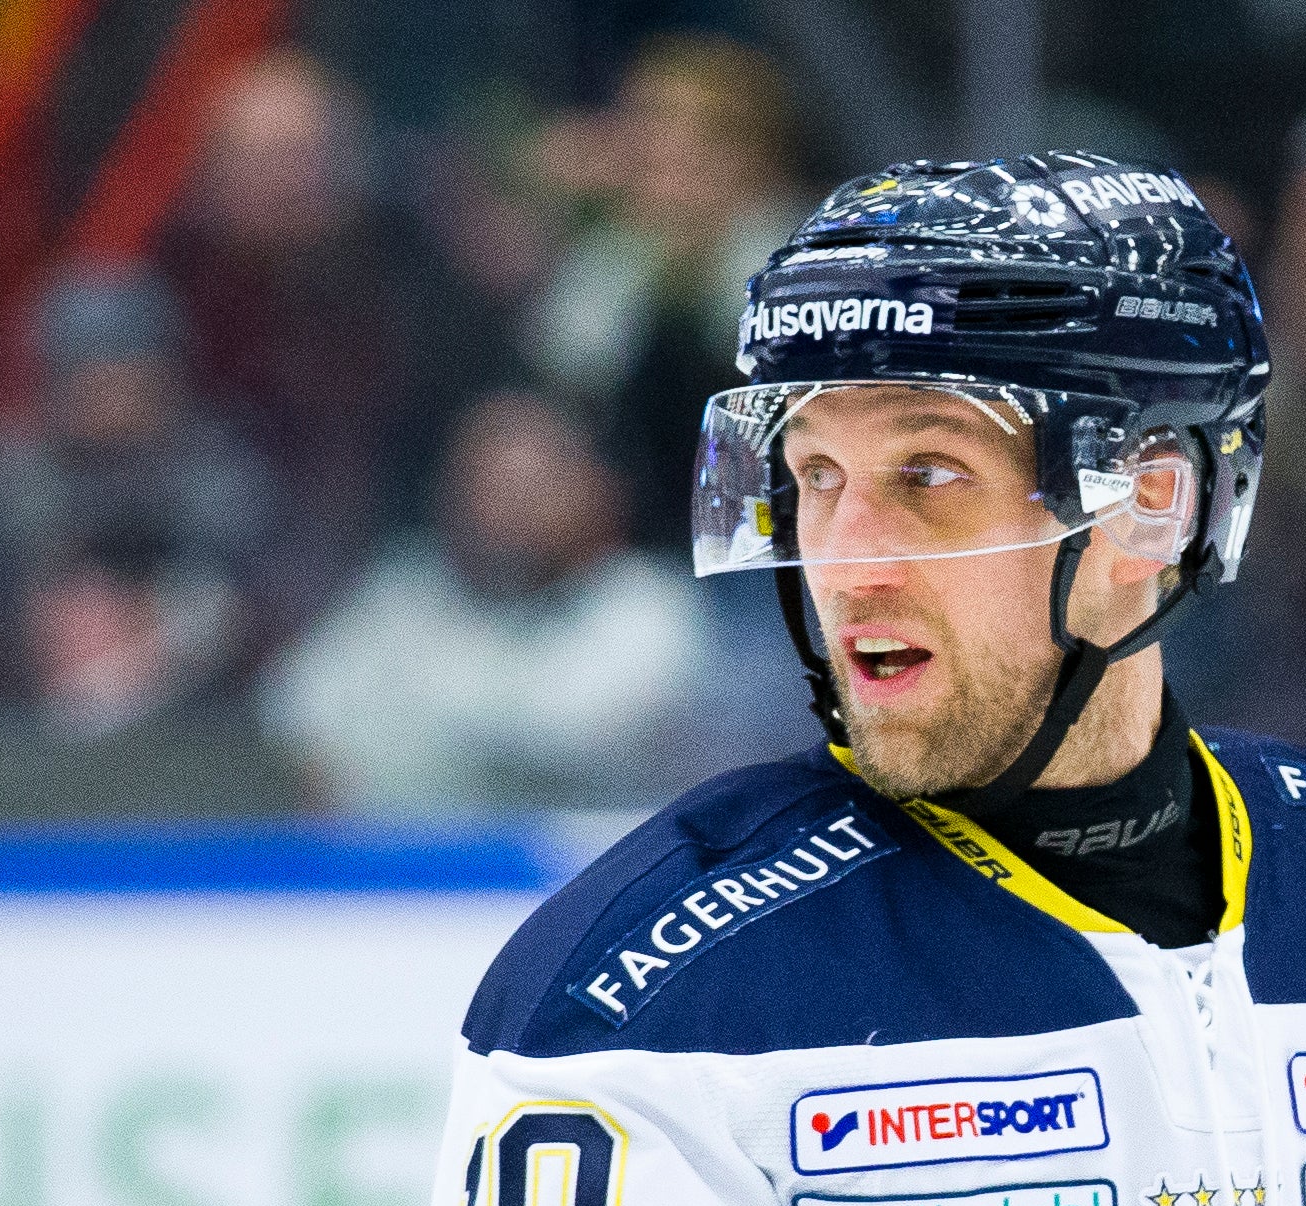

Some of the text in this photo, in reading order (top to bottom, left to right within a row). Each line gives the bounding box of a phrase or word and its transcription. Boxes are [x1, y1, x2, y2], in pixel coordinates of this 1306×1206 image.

[746, 298, 934, 341] Husqvarna
[1114, 295, 1218, 328] BAUER
[586, 815, 876, 1014] FAGERHULT
[867, 1093, 1079, 1147] INTERSPORT
